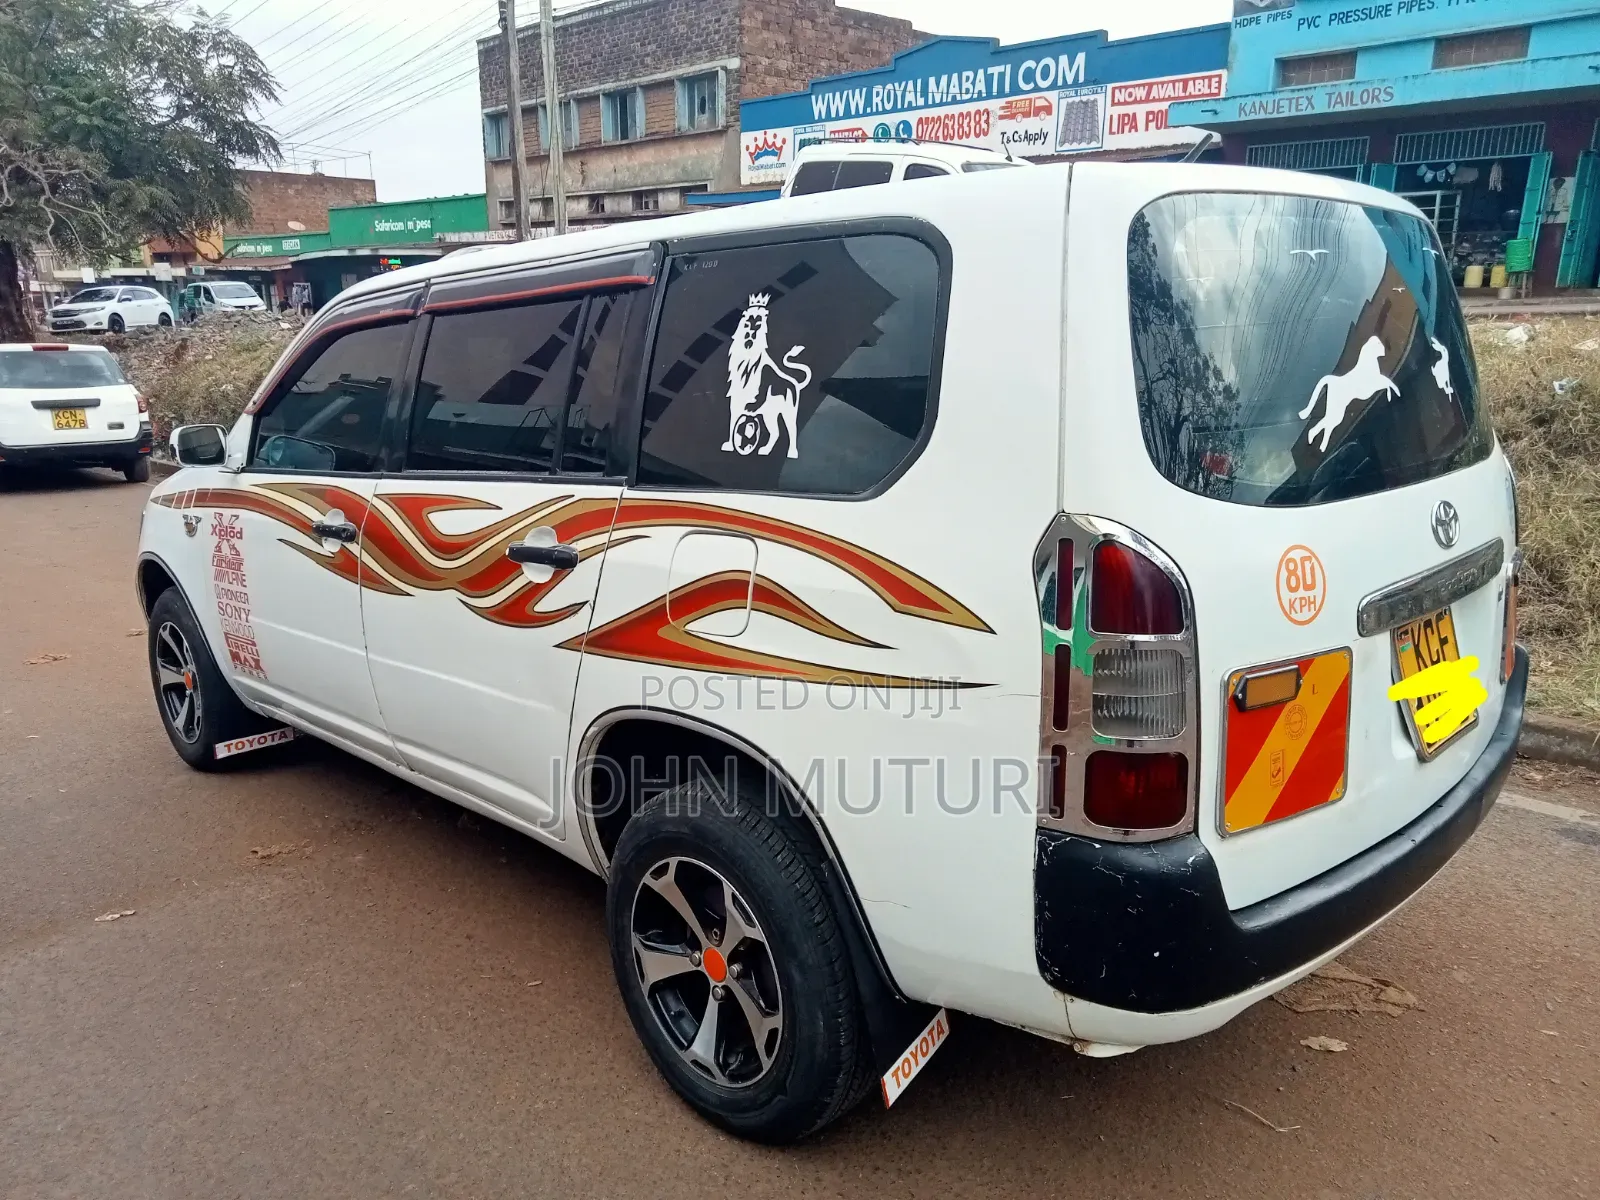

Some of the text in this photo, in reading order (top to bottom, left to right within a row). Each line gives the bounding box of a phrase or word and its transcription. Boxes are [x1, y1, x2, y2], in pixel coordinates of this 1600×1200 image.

[1234, 10, 1293, 29] HDPE PIPES
[1297, 15, 1322, 31] PVC
[1328, 3, 1393, 27] PRESSURE
[1059, 90, 1077, 98] ROYAL
[1114, 77, 1219, 103] NOW AVAILABLE
[1012, 100, 1030, 108] FREE
[1237, 86, 1395, 119] KANJETEX TAILORS
[1109, 108, 1170, 136] LIPA POL
[374, 218, 405, 232] Safaricom
[55, 410, 77, 420] KCN
[56, 419, 86, 429] 647B
[1284, 554, 1317, 594] 80
[220, 587, 250, 606] PIONEER
[1288, 595, 1317, 615] KPH
[217, 601, 251, 623] SONY
[220, 618, 255, 640] KENWOOD
[223, 631, 260, 658] PIRELLI
[1410, 609, 1449, 673] KCF
[228, 649, 265, 672] MAX
[233, 663, 269, 682] POWER
[223, 729, 289, 754] TOYOTA
[891, 1018, 945, 1089] TOYOTA
